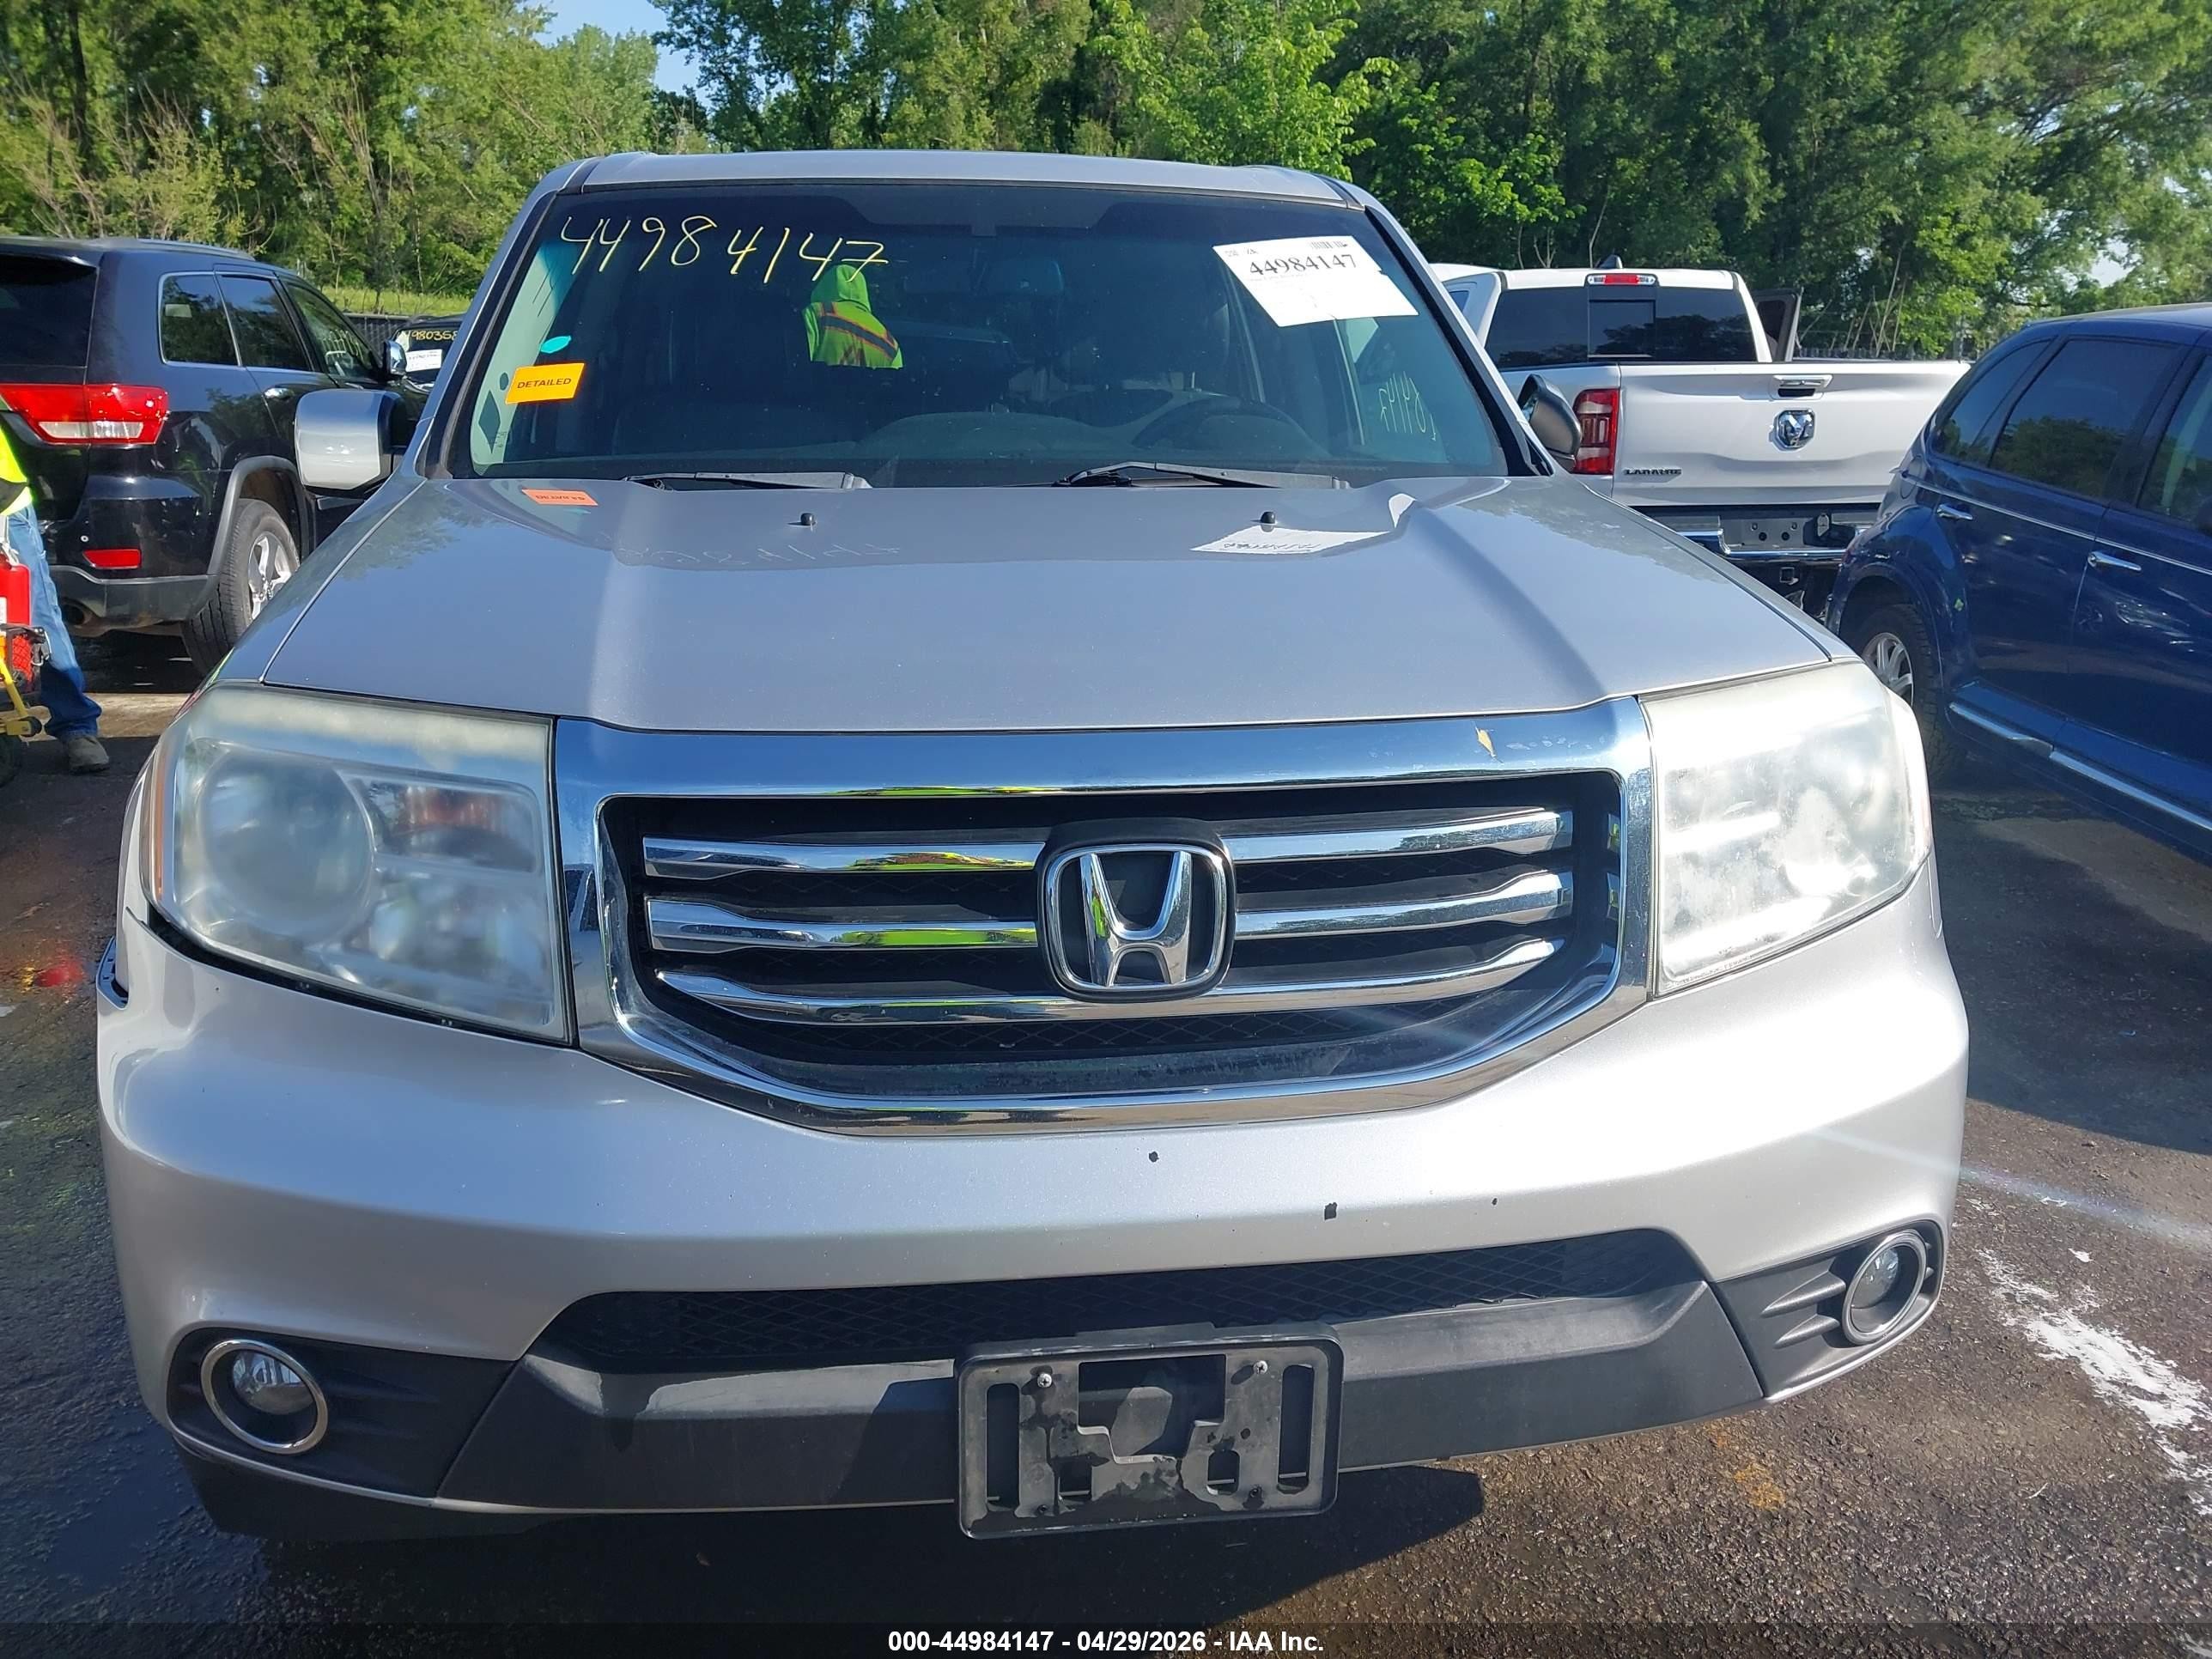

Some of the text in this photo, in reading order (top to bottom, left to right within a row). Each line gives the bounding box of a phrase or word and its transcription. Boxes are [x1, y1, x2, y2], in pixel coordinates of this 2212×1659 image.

[560, 215, 888, 283] 44984147
[1249, 253, 1357, 276] 44984147
[516, 377, 572, 389] DETAILED
